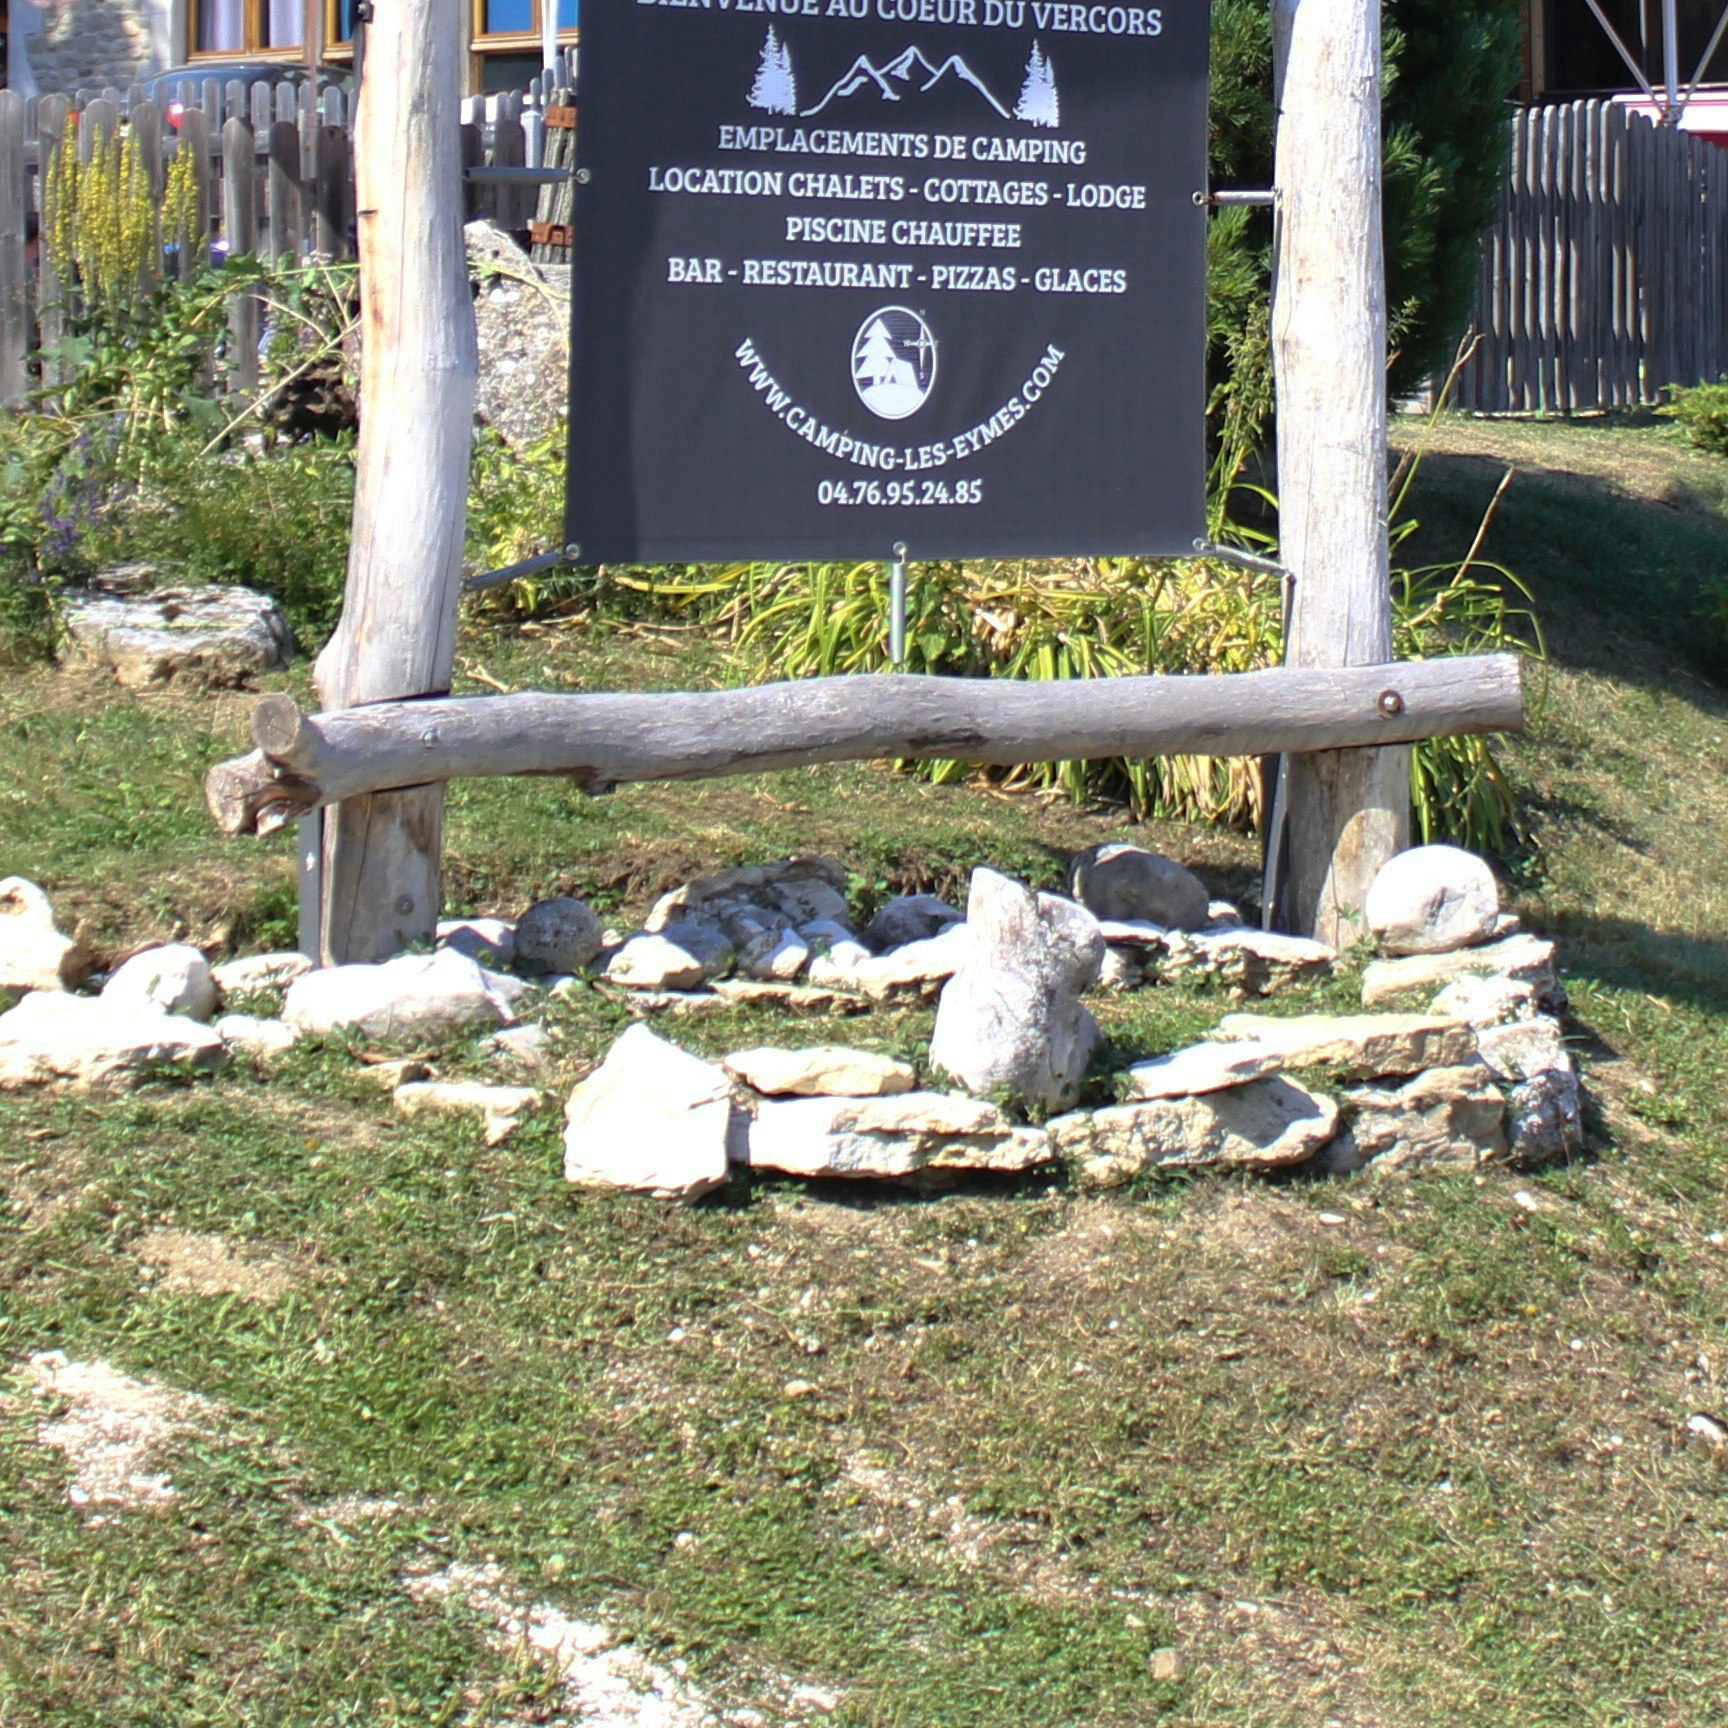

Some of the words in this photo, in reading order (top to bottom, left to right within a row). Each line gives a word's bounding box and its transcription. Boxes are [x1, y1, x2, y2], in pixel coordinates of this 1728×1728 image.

[983, 0, 1026, 28] DU
[1031, 1, 1163, 36] VERCORS
[718, 125, 928, 158] EMPLACEMENTS
[933, 135, 967, 160] DE
[972, 137, 1087, 165] CAMPING
[649, 167, 783, 196] LOCATION
[788, 173, 904, 201] CHALETS
[924, 178, 1048, 206] COTTAGES
[1066, 183, 1147, 209] LODGE
[785, 217, 886, 244] PISCINE
[891, 221, 1021, 248] CHAUFFEE
[667, 258, 722, 283] BAR
[742, 260, 912, 288] RESTAURANT
[931, 265, 1016, 290] PIZZAS
[1034, 268, 1127, 293] GLACES
[735, 338, 1065, 471] WWW.CAMPING-LES-EYMES.COM
[818, 478, 983, 505] 04.76.95.24.85
